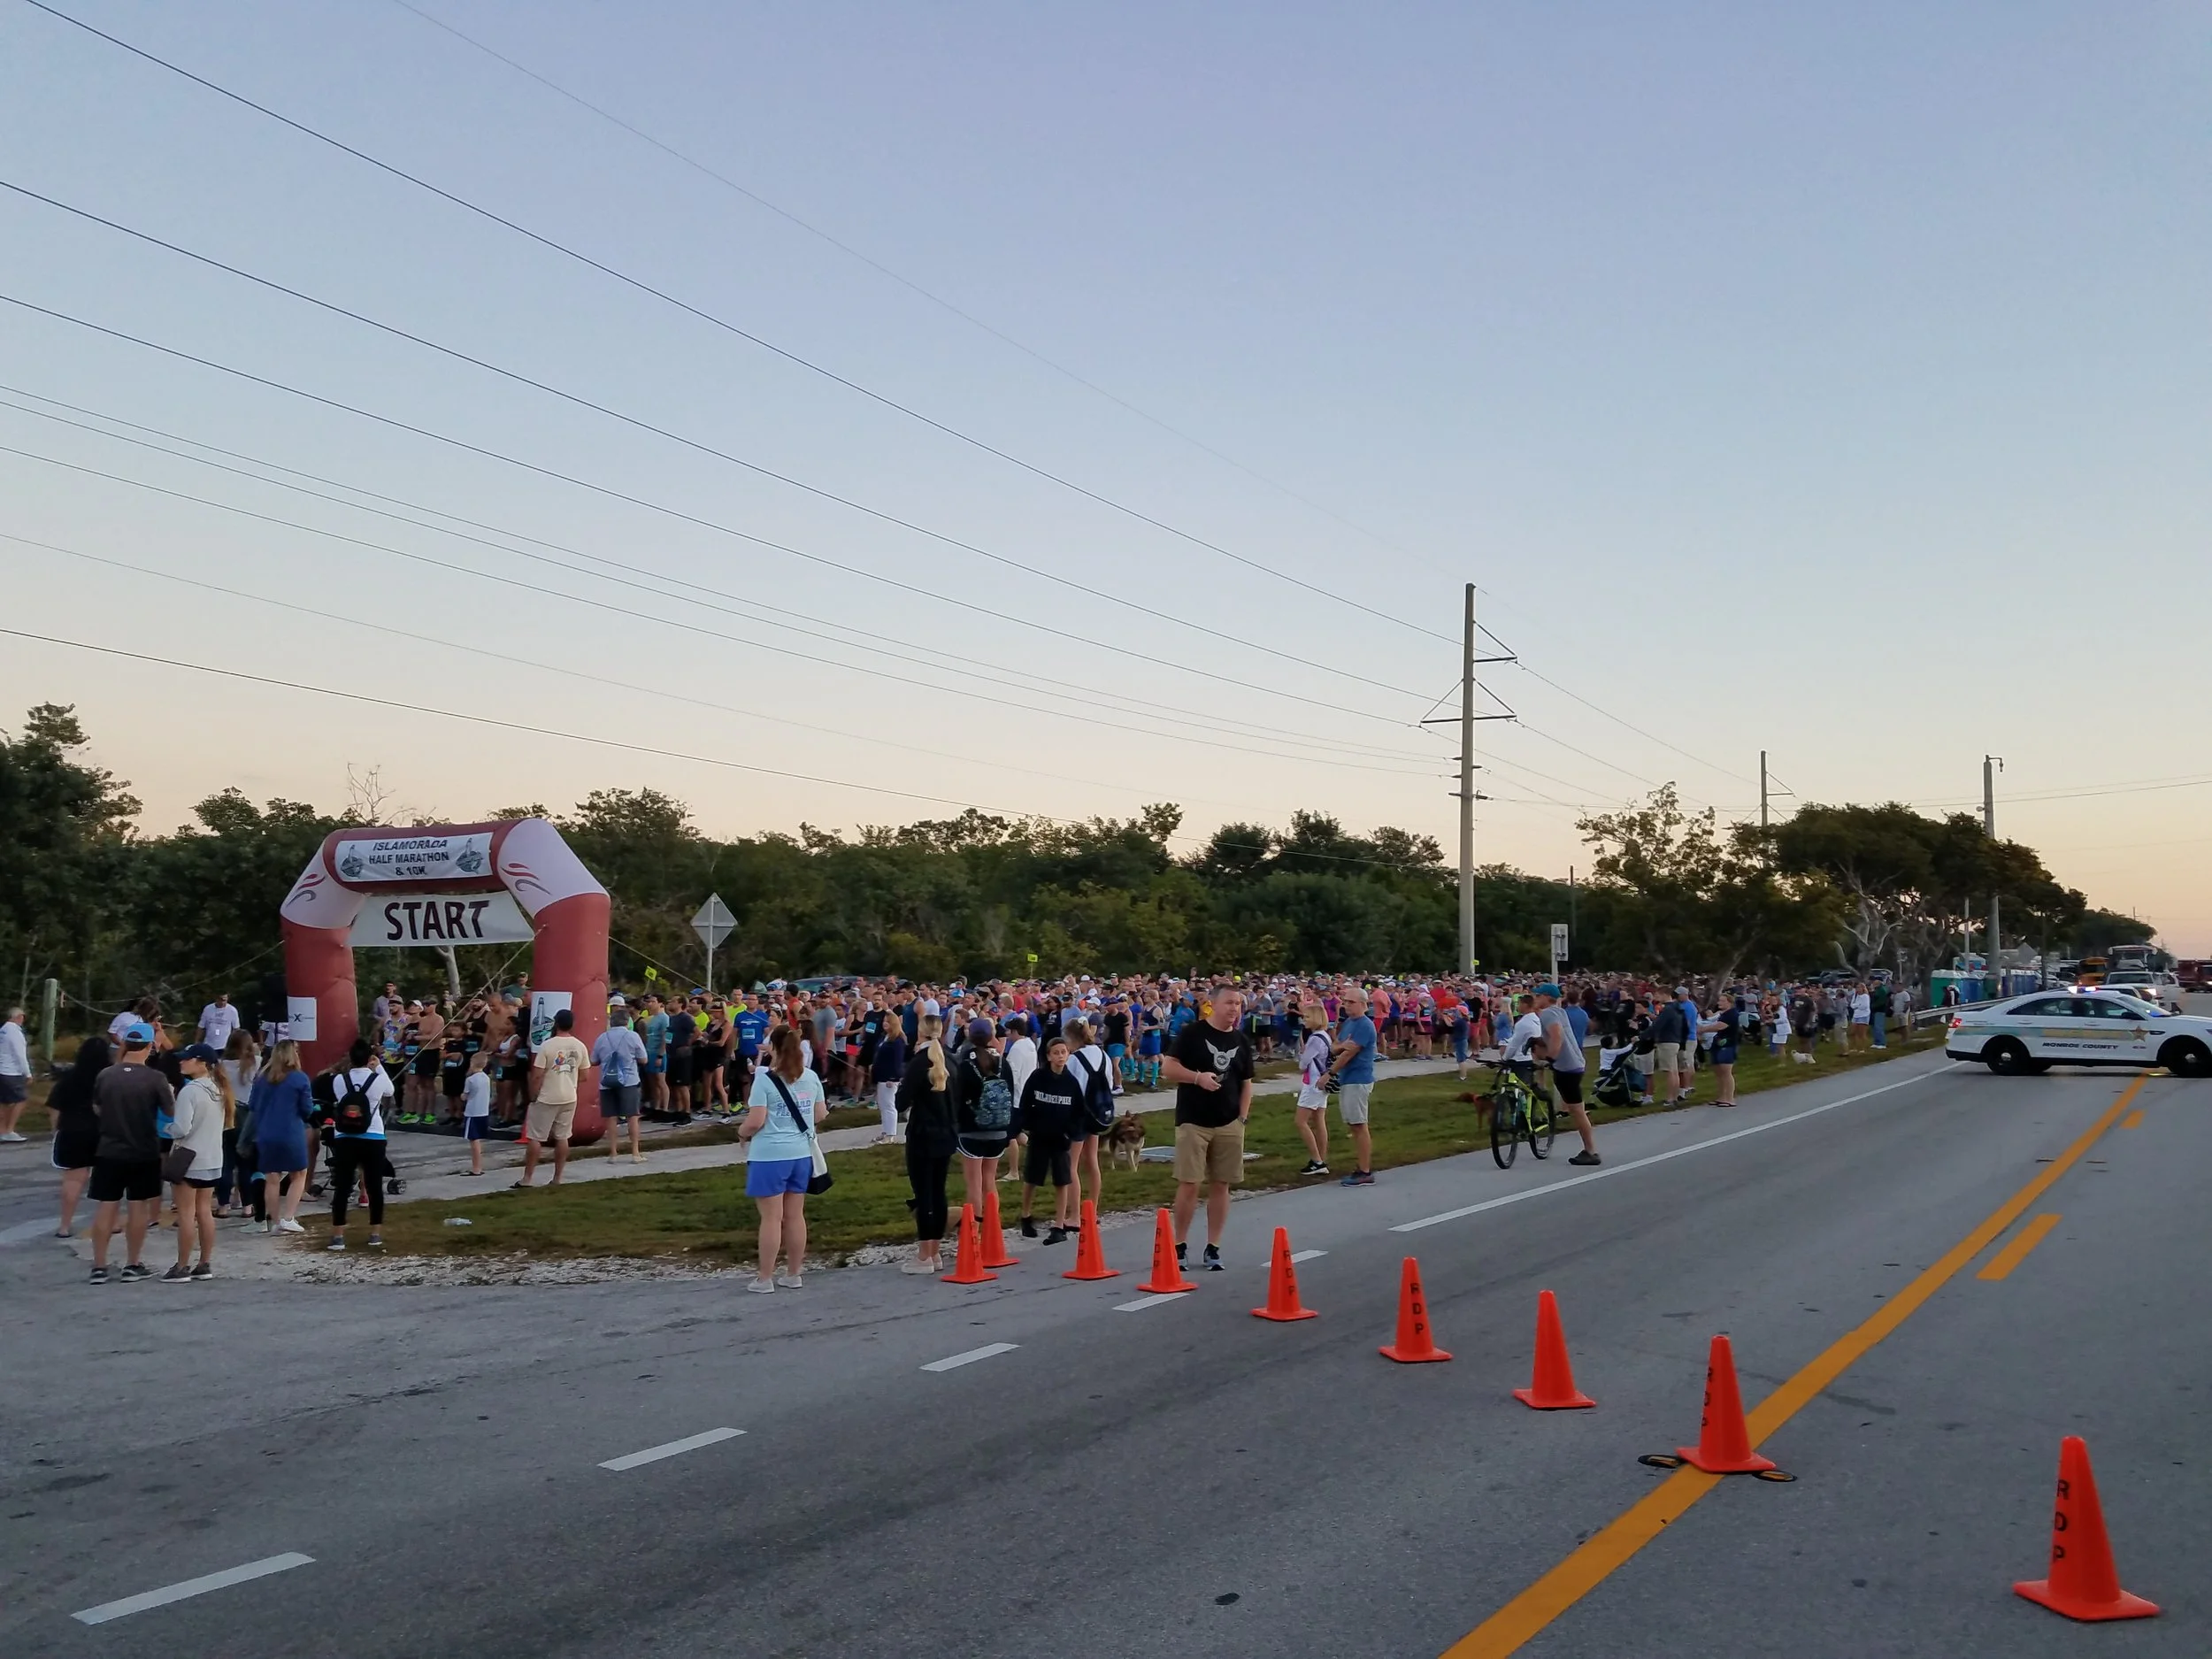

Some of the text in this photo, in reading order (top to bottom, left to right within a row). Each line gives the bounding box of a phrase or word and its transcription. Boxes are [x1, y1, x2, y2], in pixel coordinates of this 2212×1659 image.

[369, 851, 449, 864] HALF MARATHON
[373, 839, 448, 852] ISLAMORADA
[396, 865, 426, 876] & 10K
[384, 899, 489, 941] START
[777, 1100, 811, 1109] SHULD
[1284, 1250, 1295, 1296] RDP
[1410, 1283, 1425, 1335] RDP
[2053, 1479, 2070, 1563] RDP
